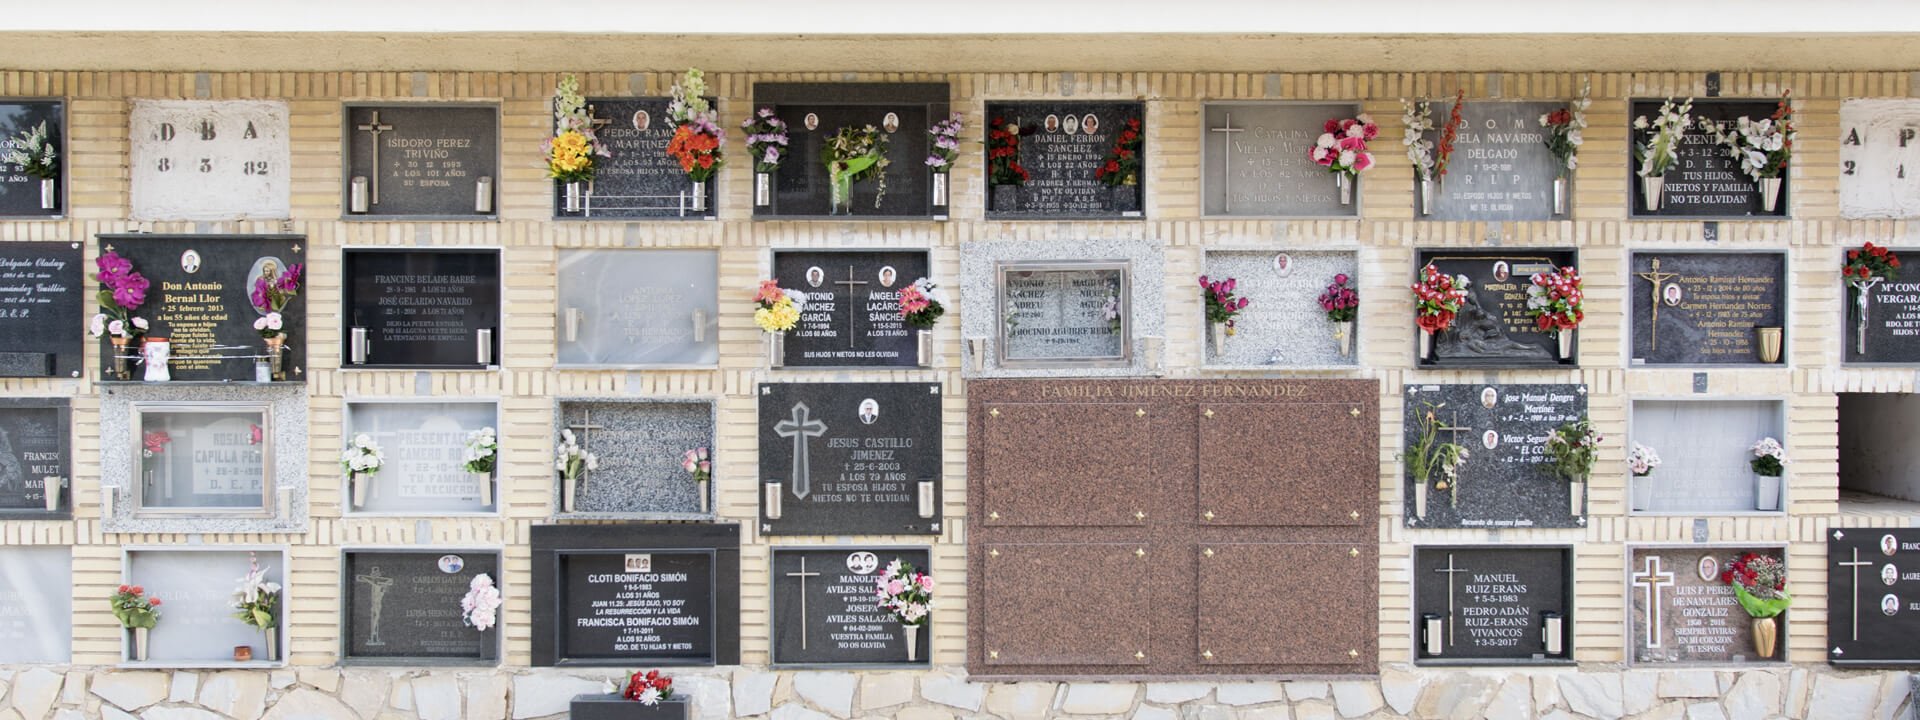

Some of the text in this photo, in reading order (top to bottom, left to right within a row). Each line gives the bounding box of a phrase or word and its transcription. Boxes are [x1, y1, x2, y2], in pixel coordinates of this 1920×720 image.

[161, 120, 258, 140] D B A
[1487, 133, 1542, 143] NAVARRO
[1843, 128, 1915, 147] A P
[388, 139, 470, 147] ISIDORO PEREZ
[1048, 144, 1092, 153] SANCHEZ
[405, 149, 448, 158] TRIVIÑO
[1468, 149, 1518, 159] DELGADO
[158, 158, 268, 175] 8 3 82
[1843, 160, 1904, 178] 2 1
[1683, 172, 1736, 181] TUS HIJOS,
[1665, 184, 1753, 192] NIETOS Y FAMILIA
[1671, 195, 1747, 203] NO TE OLVIDAN
[163, 282, 222, 290] Don Antonio
[165, 294, 220, 302] Bernal Llor
[802, 312, 831, 322] GARCÍA
[1041, 385, 1307, 397] FAMILIA JIMENEZ FERNANDEZ
[1522, 393, 1547, 401] Manuel
[827, 438, 912, 448] JESUS CASTILLO
[1521, 446, 1529, 454] EL
[195, 451, 237, 463] CAPILLA
[851, 450, 894, 460] JIMENEZ
[210, 480, 242, 489] D. E.
[822, 483, 905, 491] TU ESPOSA HIJOS Y
[588, 572, 687, 583] CLOTI BONIFACIO SIMÓN
[1465, 585, 1527, 593] RUIZ ERANS
[1676, 586, 1696, 594] LUIS
[1673, 597, 1737, 605] DE NANCLARES
[1464, 605, 1529, 615] PEDRO ADÁN
[1683, 608, 1728, 616] GONZALEZ
[578, 615, 699, 626] FRANCISCA BONIFACIO SIMÓN
[1465, 618, 1528, 626] RUIZ-ERANS
[1470, 629, 1522, 637] VIVANCOS
